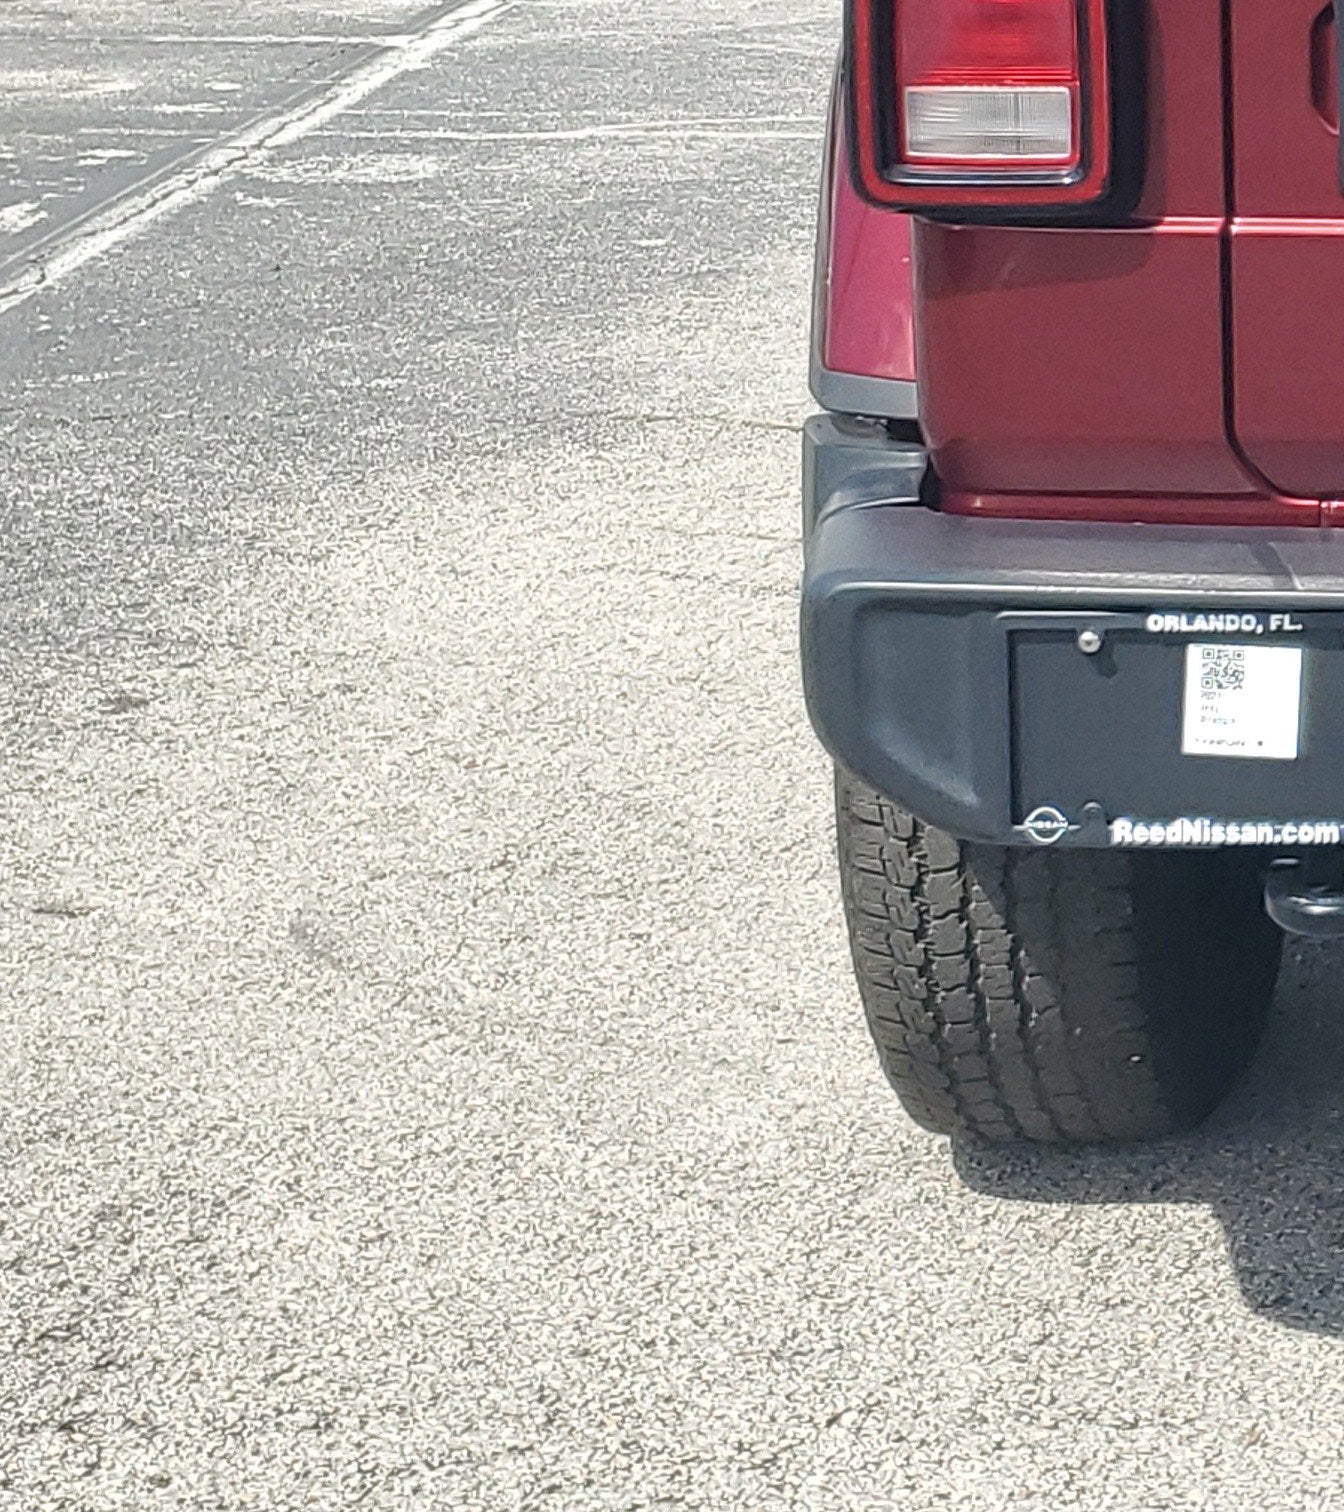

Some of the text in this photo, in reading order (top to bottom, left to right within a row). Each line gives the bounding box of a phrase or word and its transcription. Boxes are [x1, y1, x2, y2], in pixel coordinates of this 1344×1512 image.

[1147, 613, 1303, 635] ORLANDO, FL.
[1112, 818, 1341, 846] ReedNissan.com
